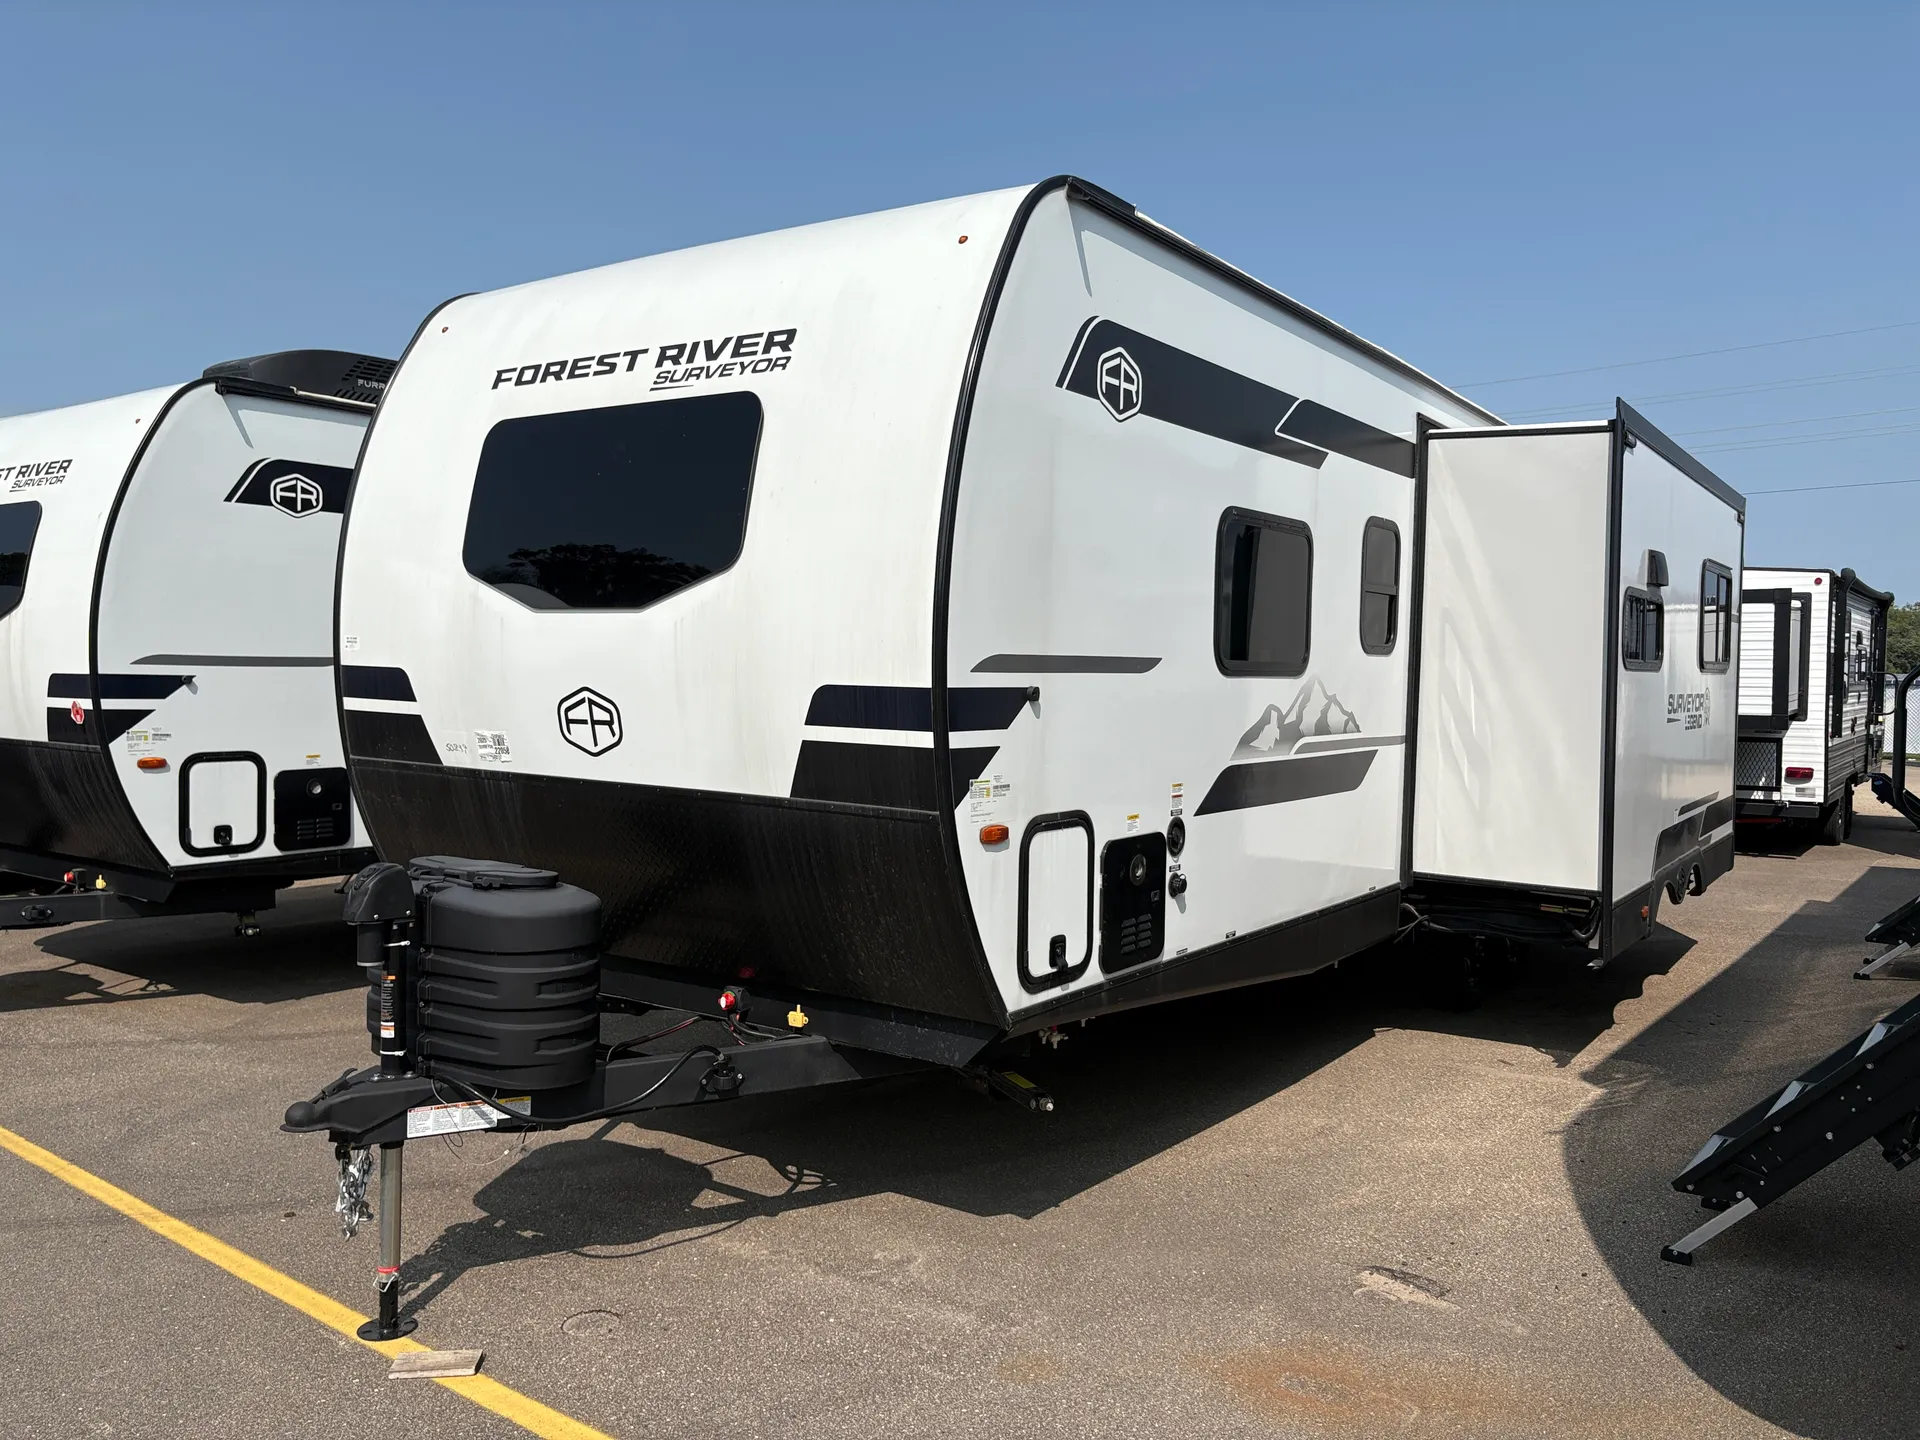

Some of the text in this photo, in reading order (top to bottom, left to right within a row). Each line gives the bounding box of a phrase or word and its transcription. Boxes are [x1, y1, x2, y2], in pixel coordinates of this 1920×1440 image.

[491, 328, 798, 391] FOREST RIVER
[652, 355, 793, 386] SURVEYOR
[15, 458, 74, 480] RIVER
[11, 474, 67, 489] SURVEYOR
[1667, 693, 1705, 715] SURVEYOR
